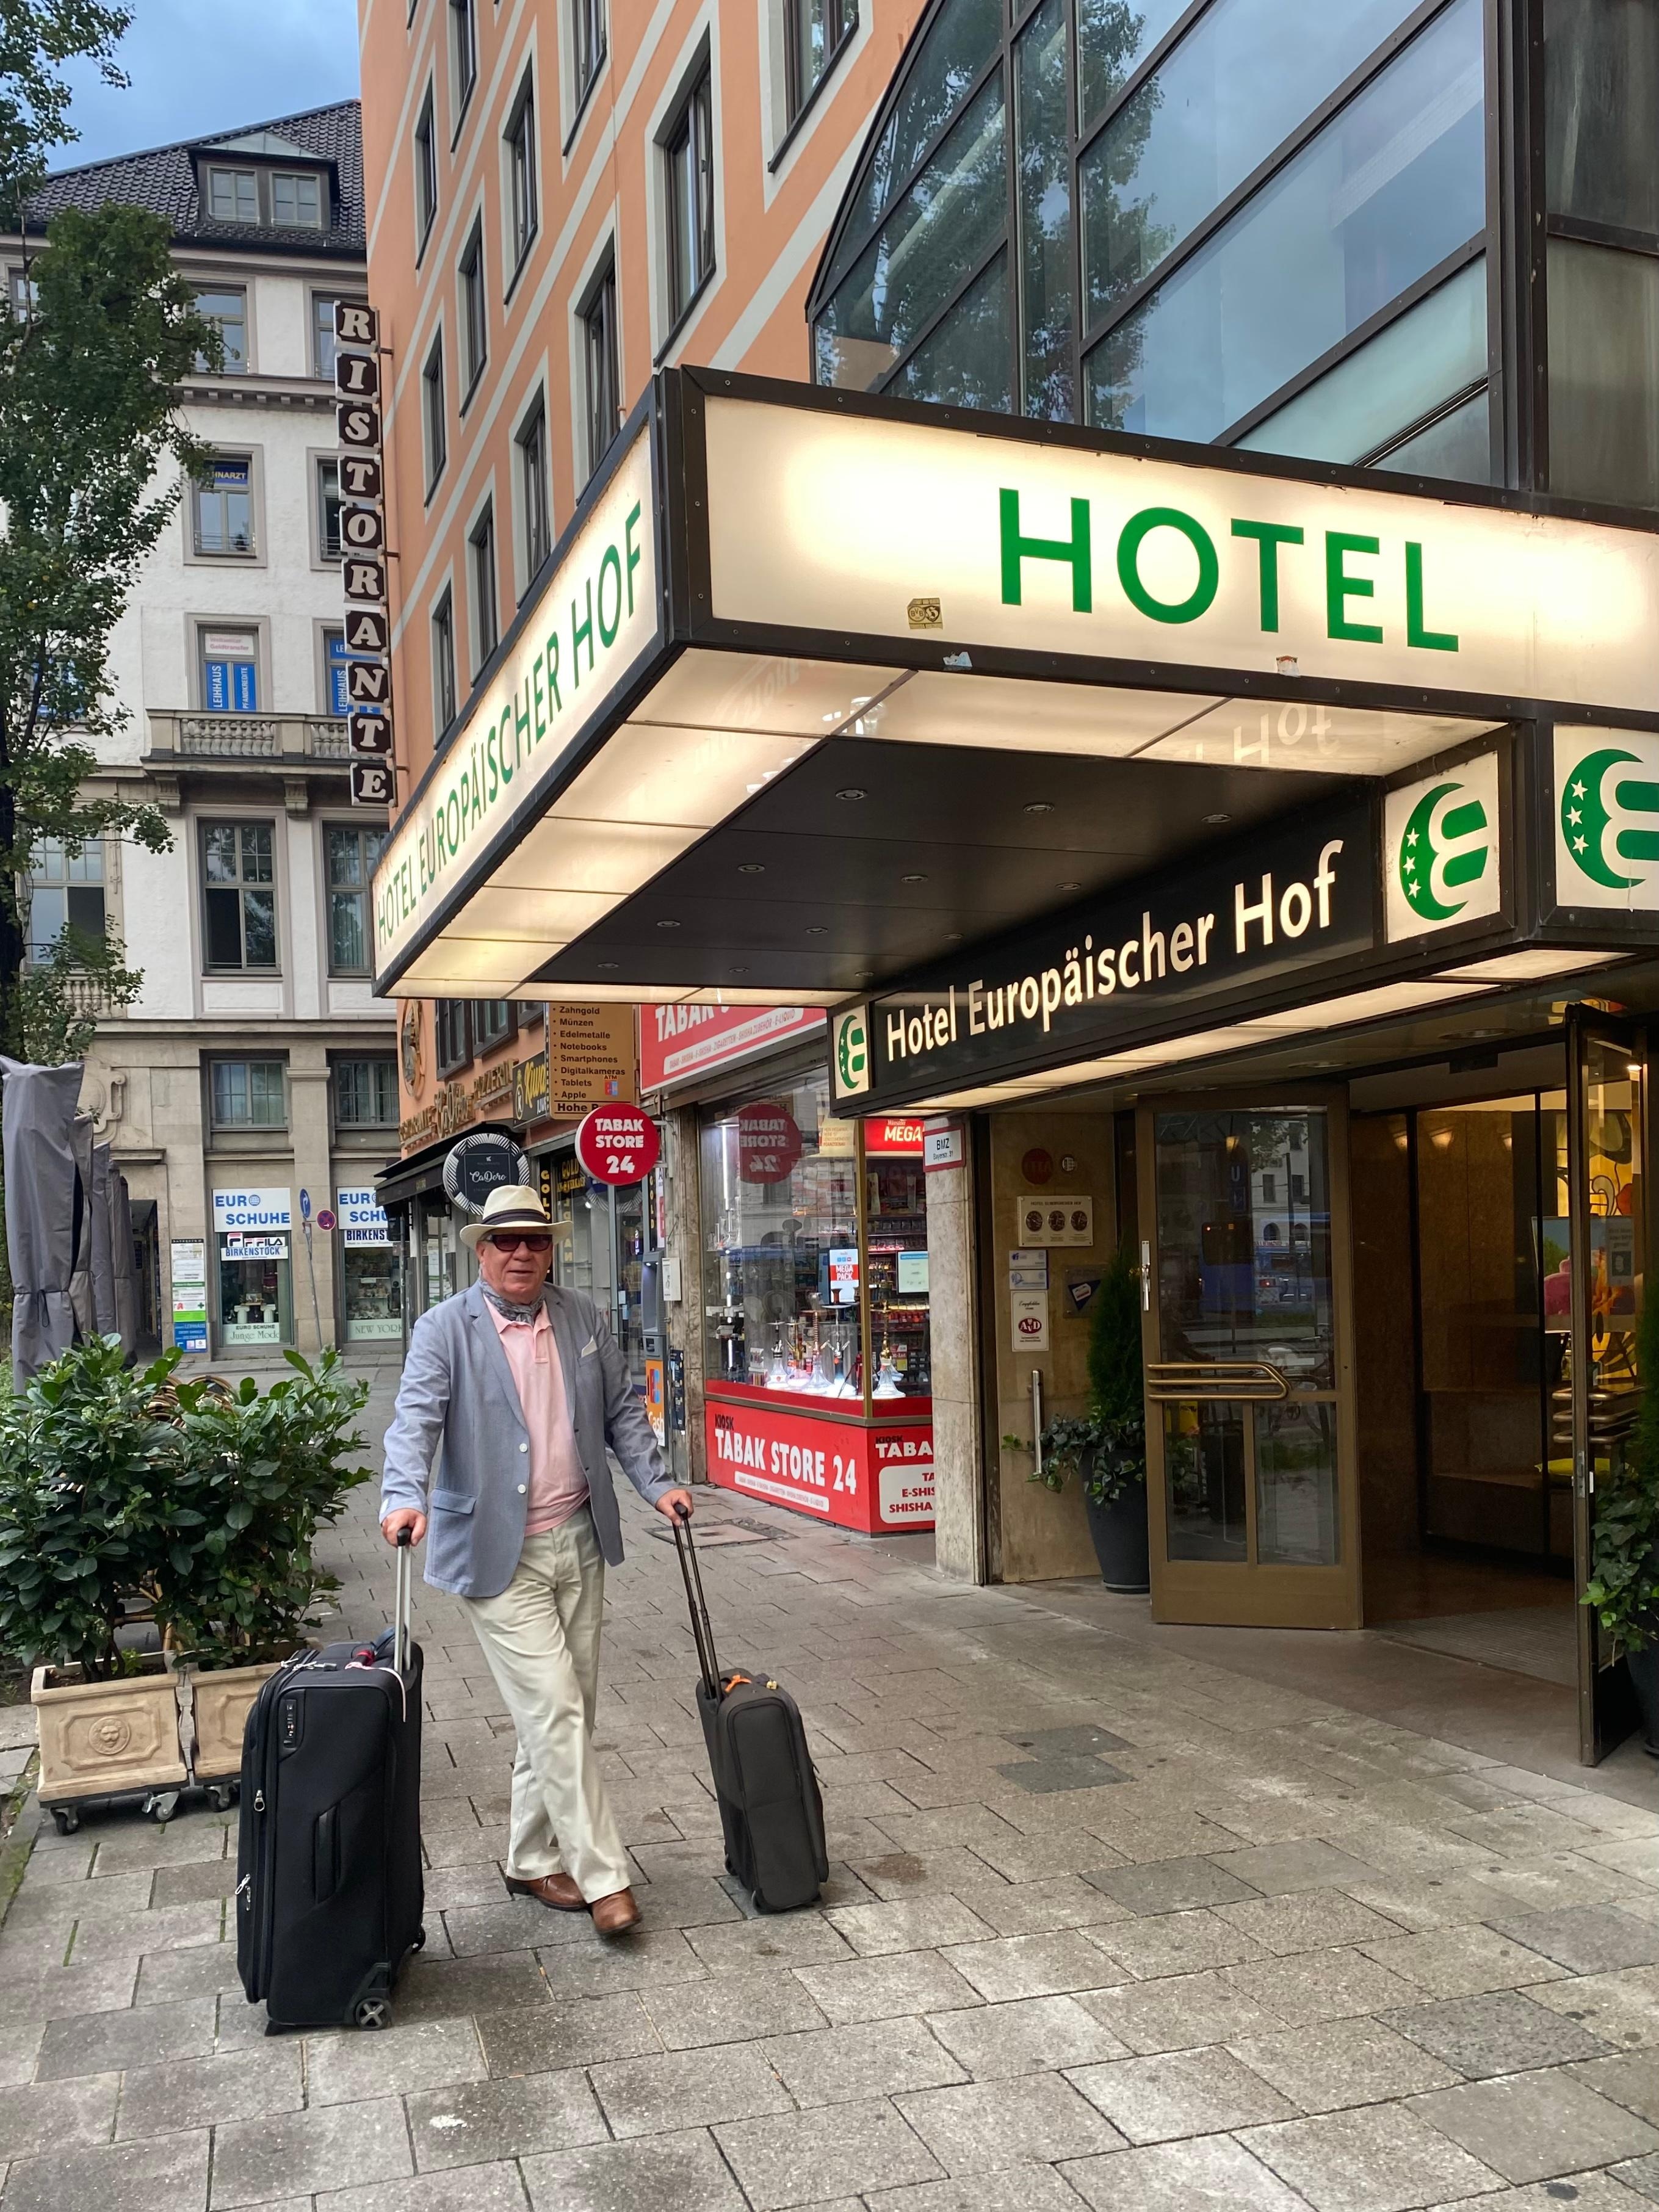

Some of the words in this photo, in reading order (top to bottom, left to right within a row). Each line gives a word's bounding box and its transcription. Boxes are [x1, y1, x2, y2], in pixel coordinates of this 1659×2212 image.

[339, 307, 387, 798] RISTORANTE
[999, 488, 1459, 652] HOTEL
[212, 665, 223, 708] LEIHHAUS
[241, 667, 250, 709] PFANDKREDITE
[337, 670, 347, 712] LEIHHAUS
[377, 856, 416, 949] HOTEL
[419, 631, 562, 899] EUROPÄISCHER
[572, 499, 642, 690] HOF
[887, 997, 957, 1061] Hotel
[969, 911, 1215, 1032] Europäischer
[1234, 839, 1344, 954] Hof
[560, 1007, 600, 1016] Zahngold
[560, 1018, 593, 1027] Münzen
[560, 1030, 610, 1039] Edelmetalle
[560, 1043, 607, 1051] Notebooks
[560, 1055, 618, 1064] Smartphones
[561, 1067, 626, 1076] Digitalkameras
[562, 1091, 587, 1100] Apple
[557, 1103, 588, 1111] Hohe
[595, 1118, 644, 1132] TABAK
[595, 1135, 644, 1148] STORE
[936, 1138, 950, 1151] BMZ
[562, 1159, 579, 1178] GOLD
[606, 1155, 635, 1173] 24
[541, 1170, 551, 1220] GOLD
[226, 1212, 290, 1225] SCHUHE
[347, 1229, 386, 1240] BIRKENS
[256, 1238, 283, 1246] FILA
[226, 1247, 280, 1257] BIRKENSTOCK
[355, 1325, 374, 1334] NEW
[715, 1414, 734, 1430] KIOSK
[875, 1435, 903, 1444] KIOSK
[875, 1441, 933, 1459] TABA
[715, 1428, 766, 1470] TABAK
[771, 1441, 825, 1486] STORE
[833, 1455, 856, 1495] 24
[889, 1502, 933, 1513] SHISHA
